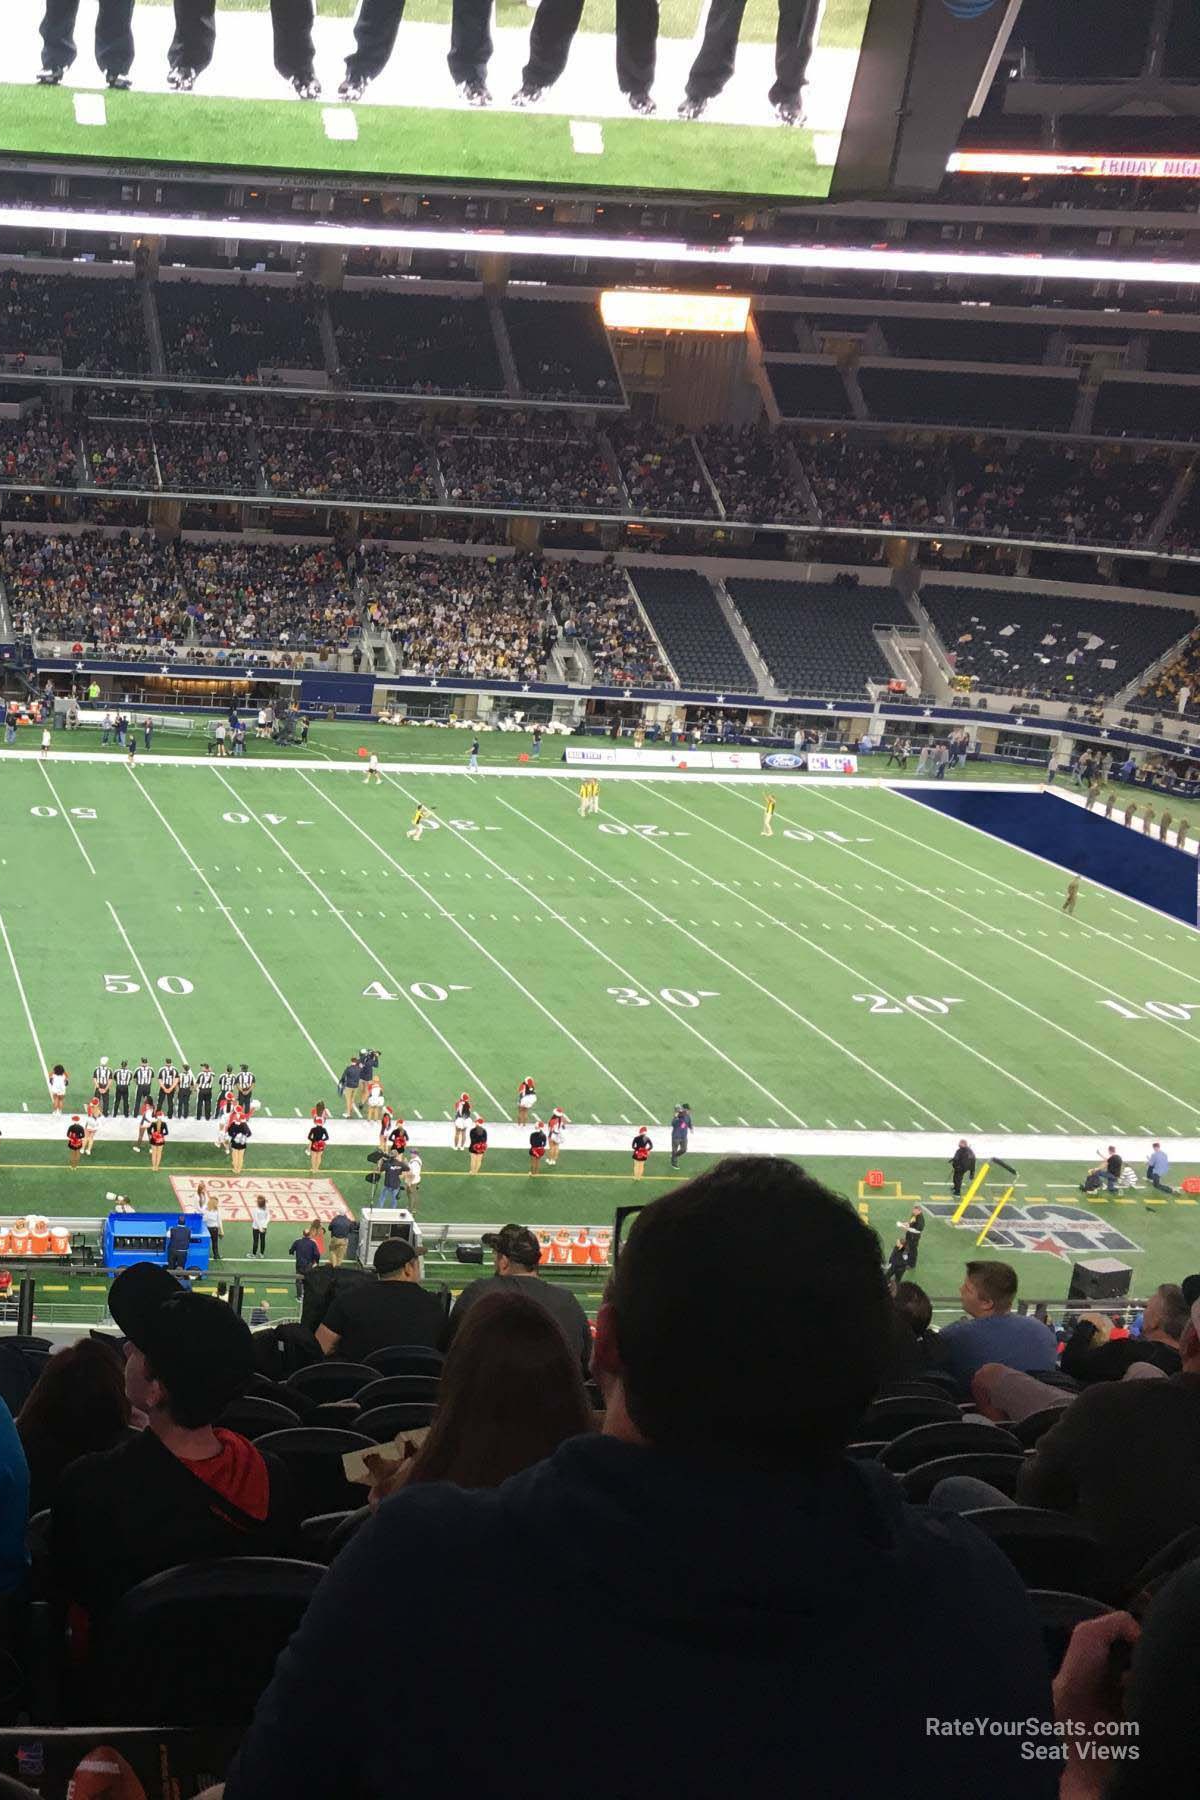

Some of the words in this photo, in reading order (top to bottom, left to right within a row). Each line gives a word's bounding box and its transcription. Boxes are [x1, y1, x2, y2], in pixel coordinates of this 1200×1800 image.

[1100, 159, 1157, 174] FRIDAY
[29, 805, 99, 819] 50
[221, 811, 289, 825] 40
[101, 973, 196, 996] 50
[360, 980, 450, 1002] 40
[606, 986, 702, 1008] 30
[851, 993, 950, 1014] 20
[1095, 999, 1192, 1021] 10
[189, 1179, 261, 1190] HOKA
[269, 1178, 314, 1191] HEY
[224, 1207, 240, 1219] 7
[293, 1208, 309, 1219] 9
